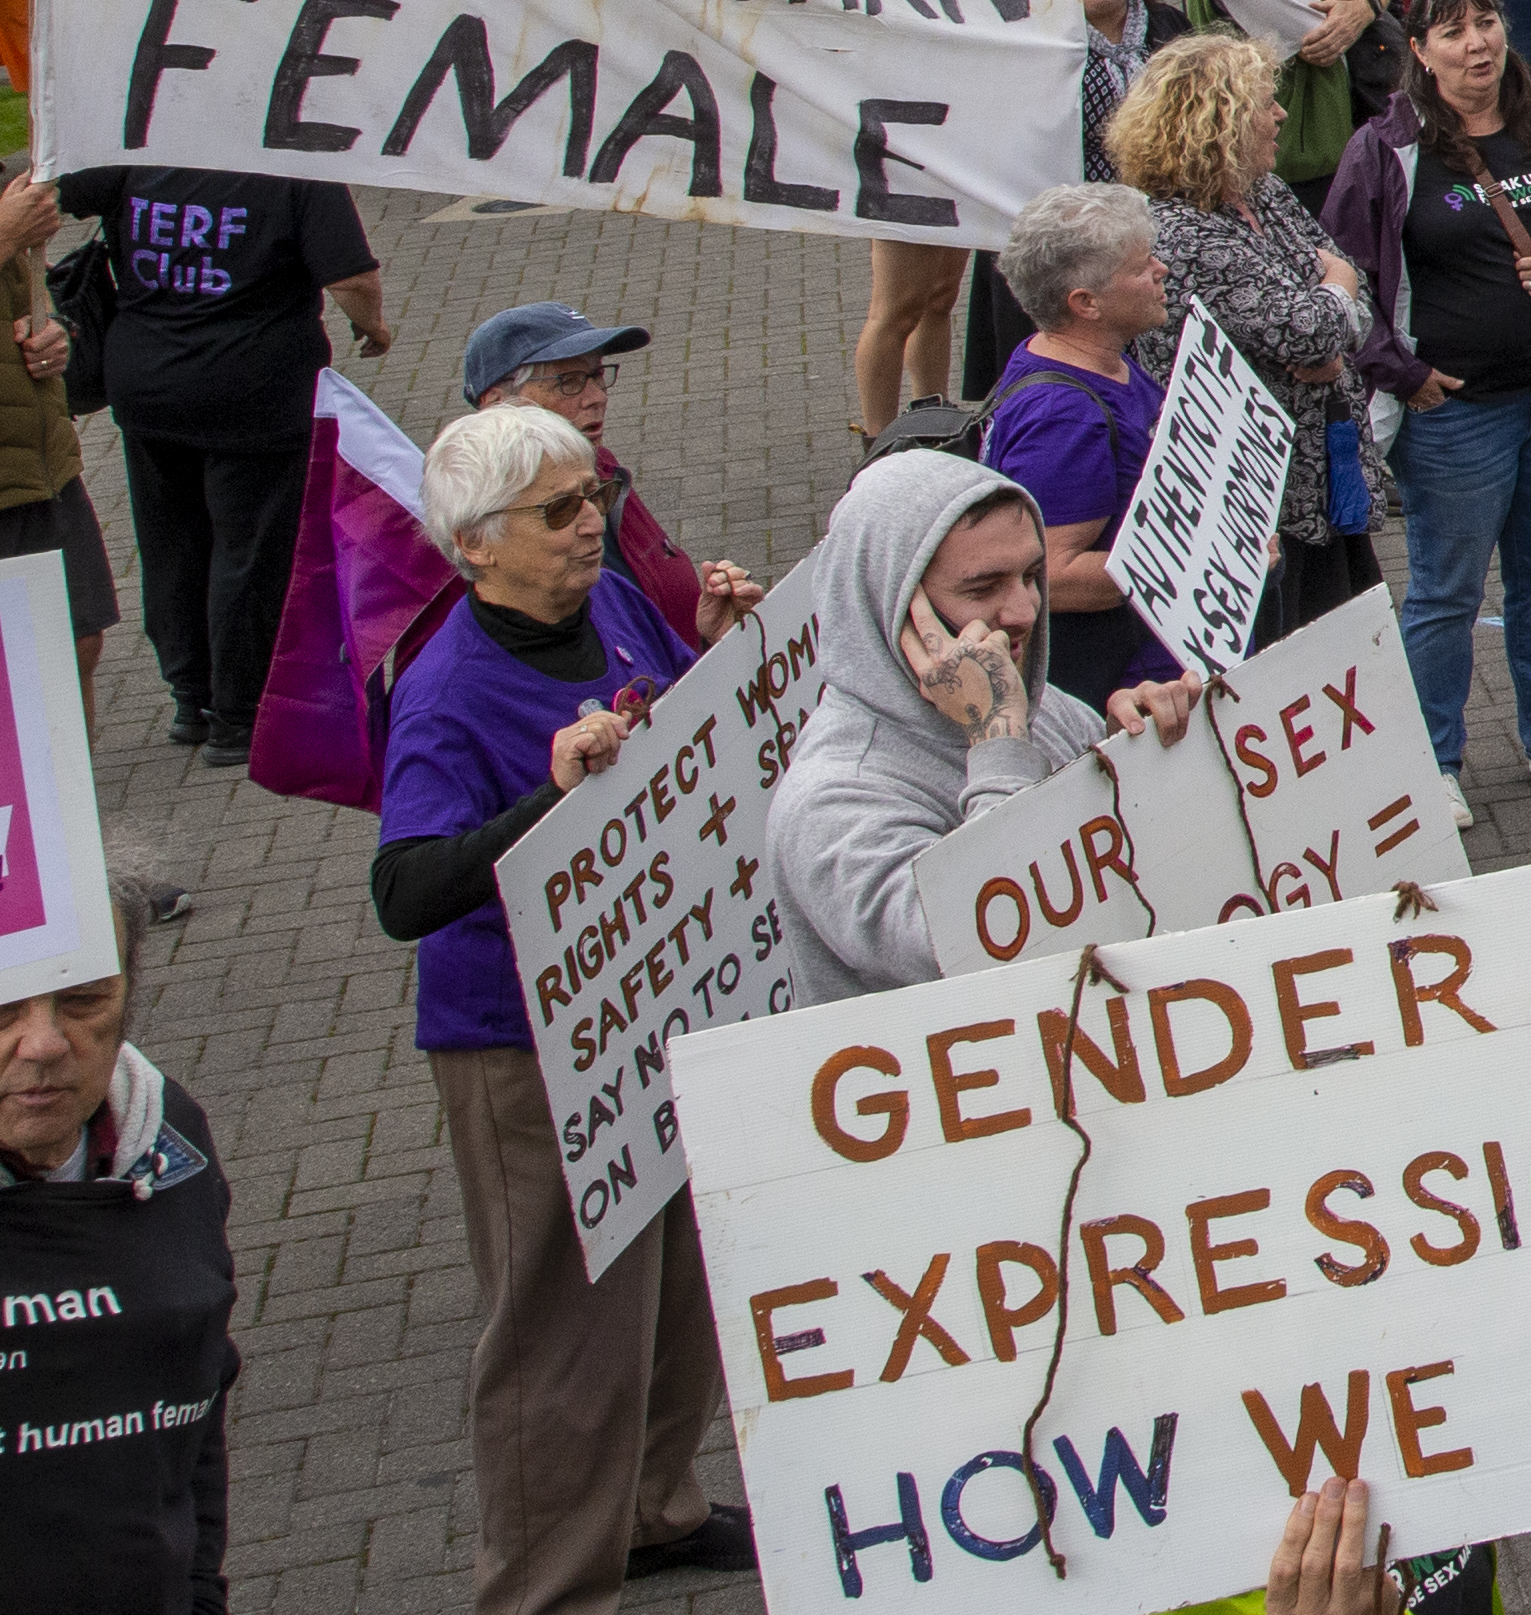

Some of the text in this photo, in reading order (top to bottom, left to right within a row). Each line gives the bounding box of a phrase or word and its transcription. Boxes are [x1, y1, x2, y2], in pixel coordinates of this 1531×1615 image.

[130, 196, 248, 249] TERF
[131, 248, 233, 296] Club
[1121, 342, 1233, 627] AUTHENTICITY
[1216, 386, 1294, 581] HORMONES
[1235, 665, 1376, 799] SEX
[543, 714, 720, 934] PROTECT
[974, 814, 1139, 962] OUR
[535, 850, 674, 1028] RIGHTS
[572, 887, 714, 1073] SAFETY
[562, 1065, 625, 1162] SAY
[635, 1007, 690, 1078] NO
[692, 951, 741, 1019] TO
[810, 930, 1498, 1165] GENDER
[577, 1142, 637, 1232] ON
[16, 1410, 145, 1454] human
[823, 1411, 1180, 1600] HOW
[1240, 1357, 1475, 1499] WE
[1423, 1560, 1461, 1594] SEX
